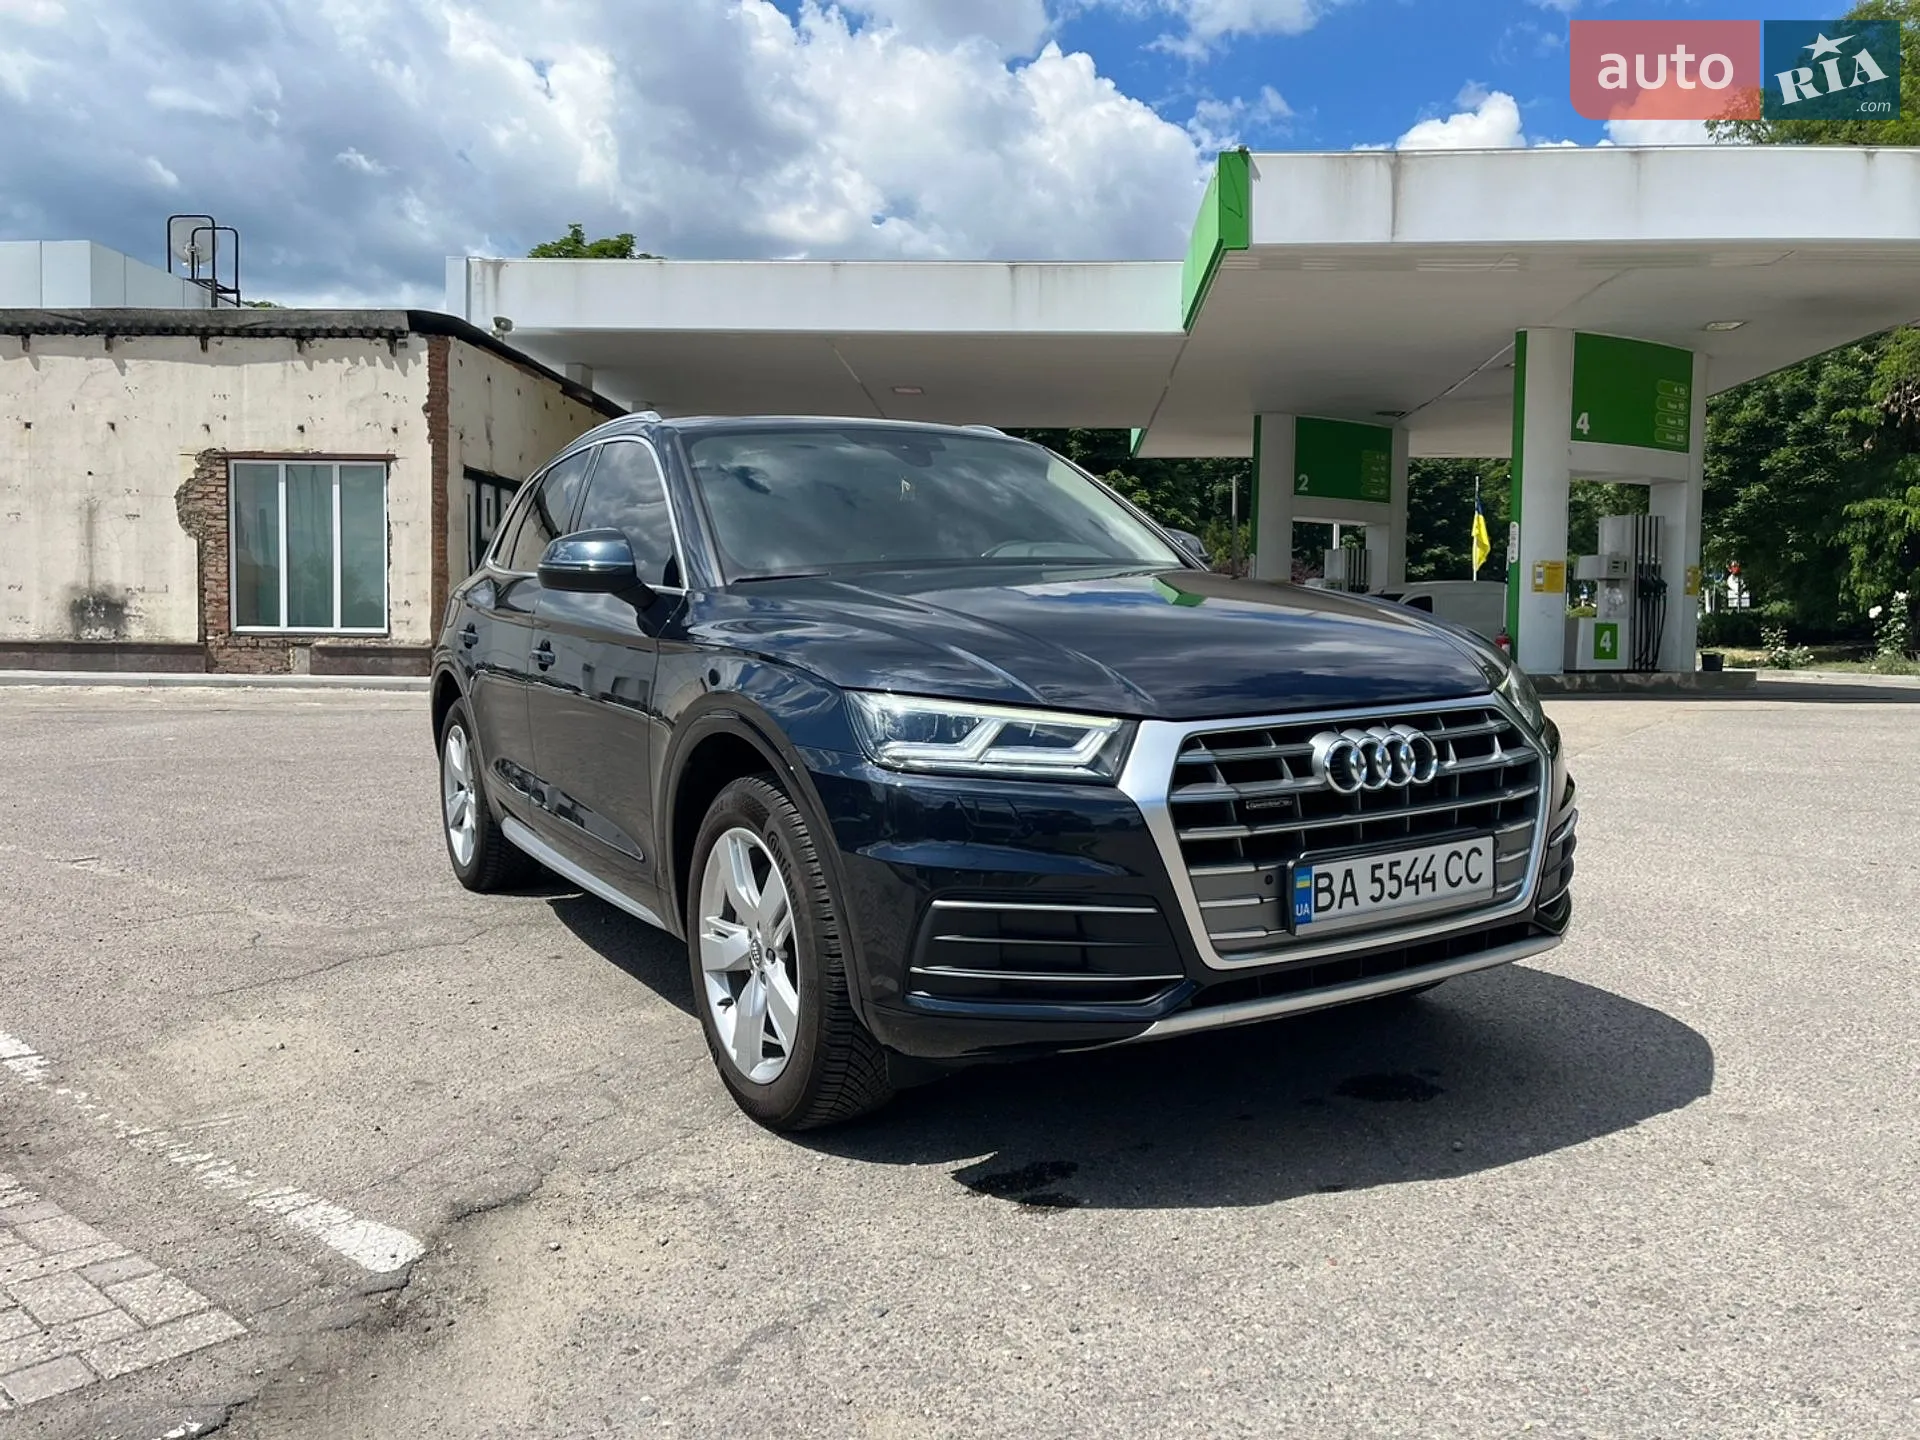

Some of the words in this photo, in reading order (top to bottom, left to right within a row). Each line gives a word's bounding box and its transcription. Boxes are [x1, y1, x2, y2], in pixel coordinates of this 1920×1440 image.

[1576, 412, 1590, 435] 4
[1298, 474, 1309, 491] 2
[1599, 630, 1612, 653] 4
[1313, 868, 1360, 914] BA
[1369, 853, 1437, 903] 5544
[1445, 846, 1483, 888] CC
[1295, 903, 1310, 917] UA
